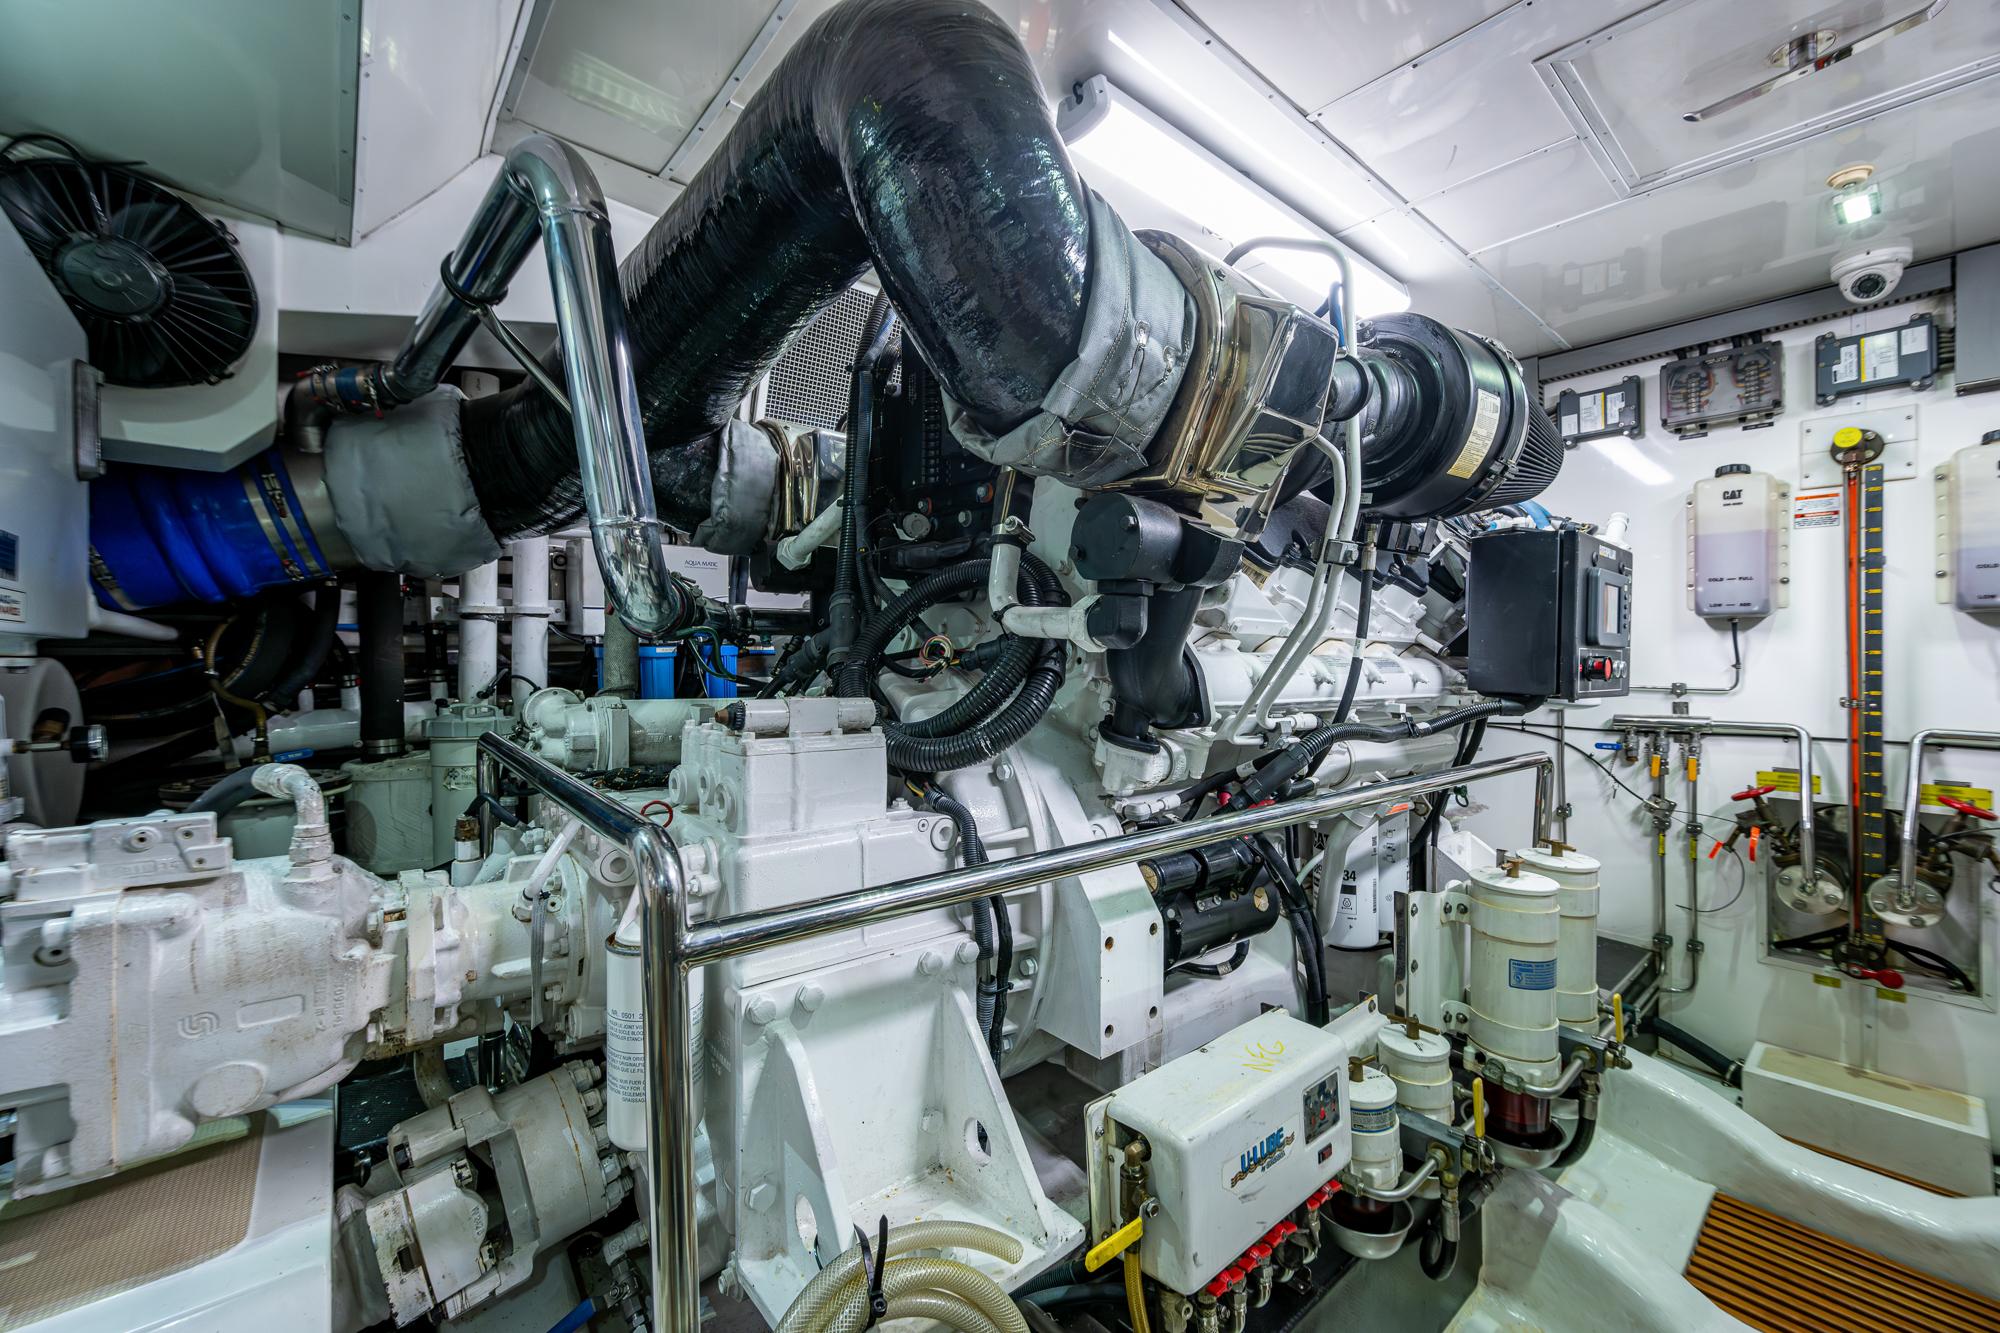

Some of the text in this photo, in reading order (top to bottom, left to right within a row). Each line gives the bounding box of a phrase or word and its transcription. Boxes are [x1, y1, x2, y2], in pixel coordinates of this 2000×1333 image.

[1722, 489, 1743, 500] CAT
[621, 1012, 635, 1020] 0501
[1241, 1127, 1284, 1173] U-LUBE
